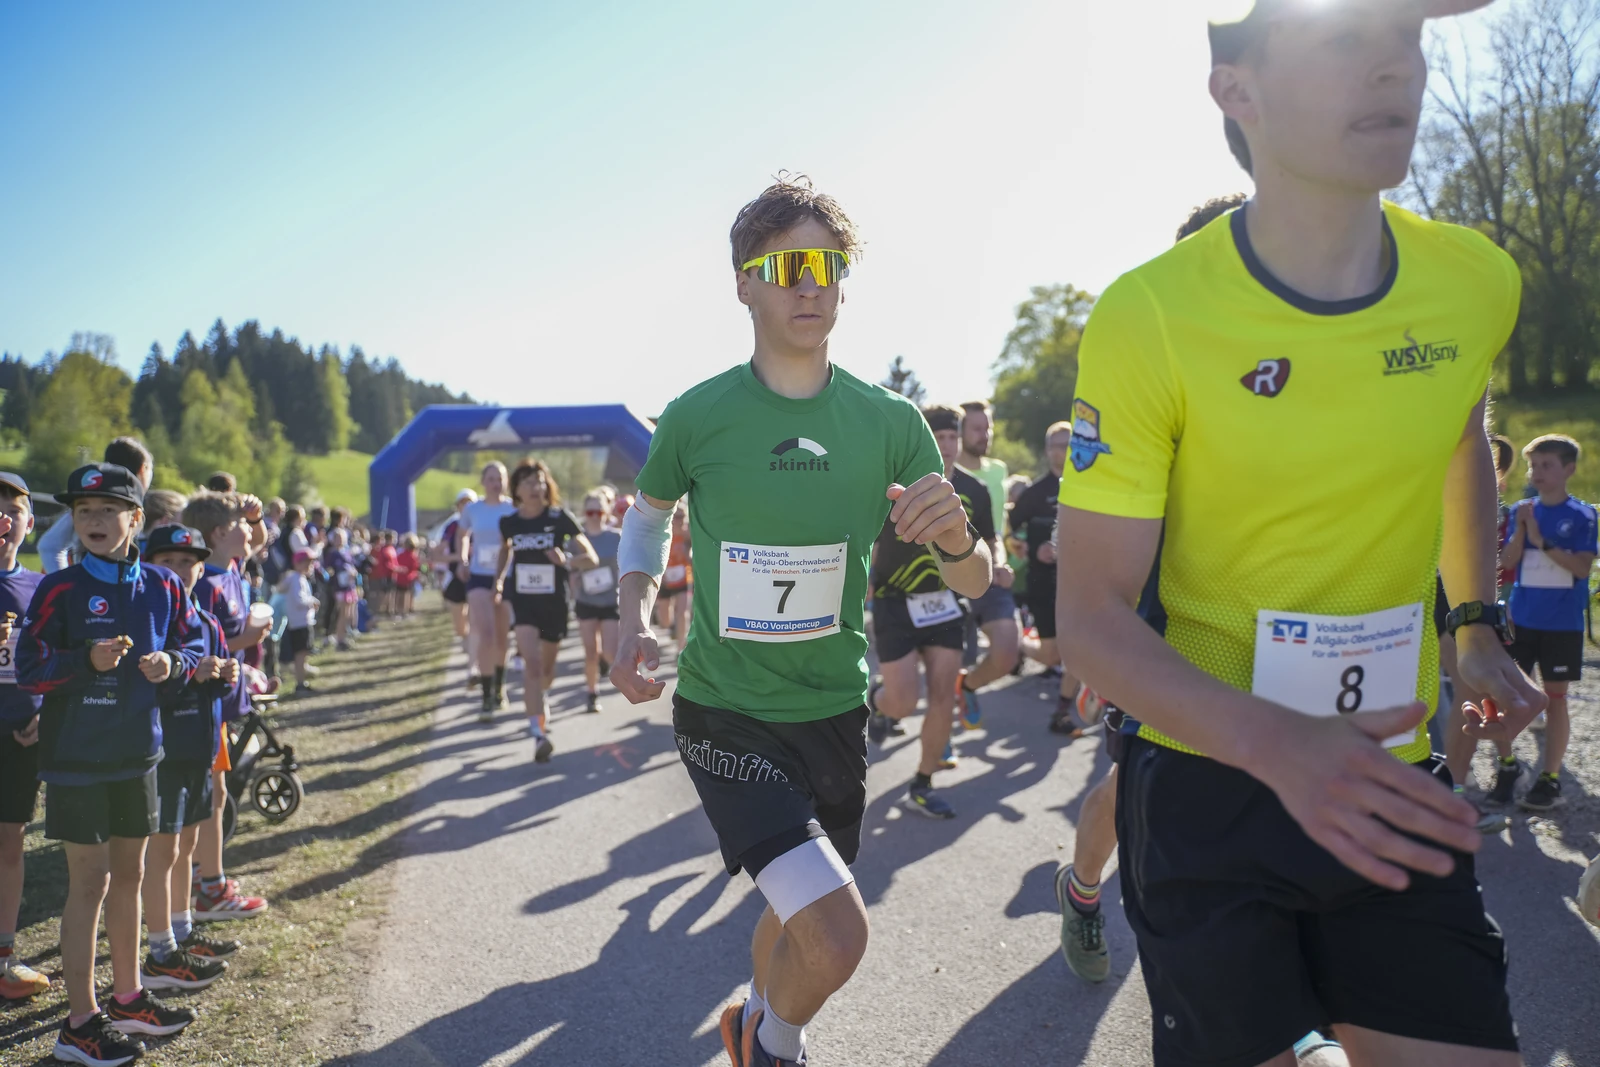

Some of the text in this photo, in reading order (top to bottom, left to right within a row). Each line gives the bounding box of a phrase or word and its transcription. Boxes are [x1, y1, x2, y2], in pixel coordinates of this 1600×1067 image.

[769, 458, 830, 472] skinfit
[752, 549, 790, 558] Volksbank
[752, 557, 831, 567] Allgäu-Oberschwaben
[772, 580, 796, 614] 7
[744, 620, 821, 631] VBAO Voralpencup
[1315, 621, 1365, 633] Volksbank
[1313, 626, 1404, 648] Allgäu-Oberschwaben
[1311, 649, 1325, 658] Für
[1327, 650, 1340, 658] die
[1335, 664, 1365, 715] 8
[82, 696, 117, 705] Schreiber
